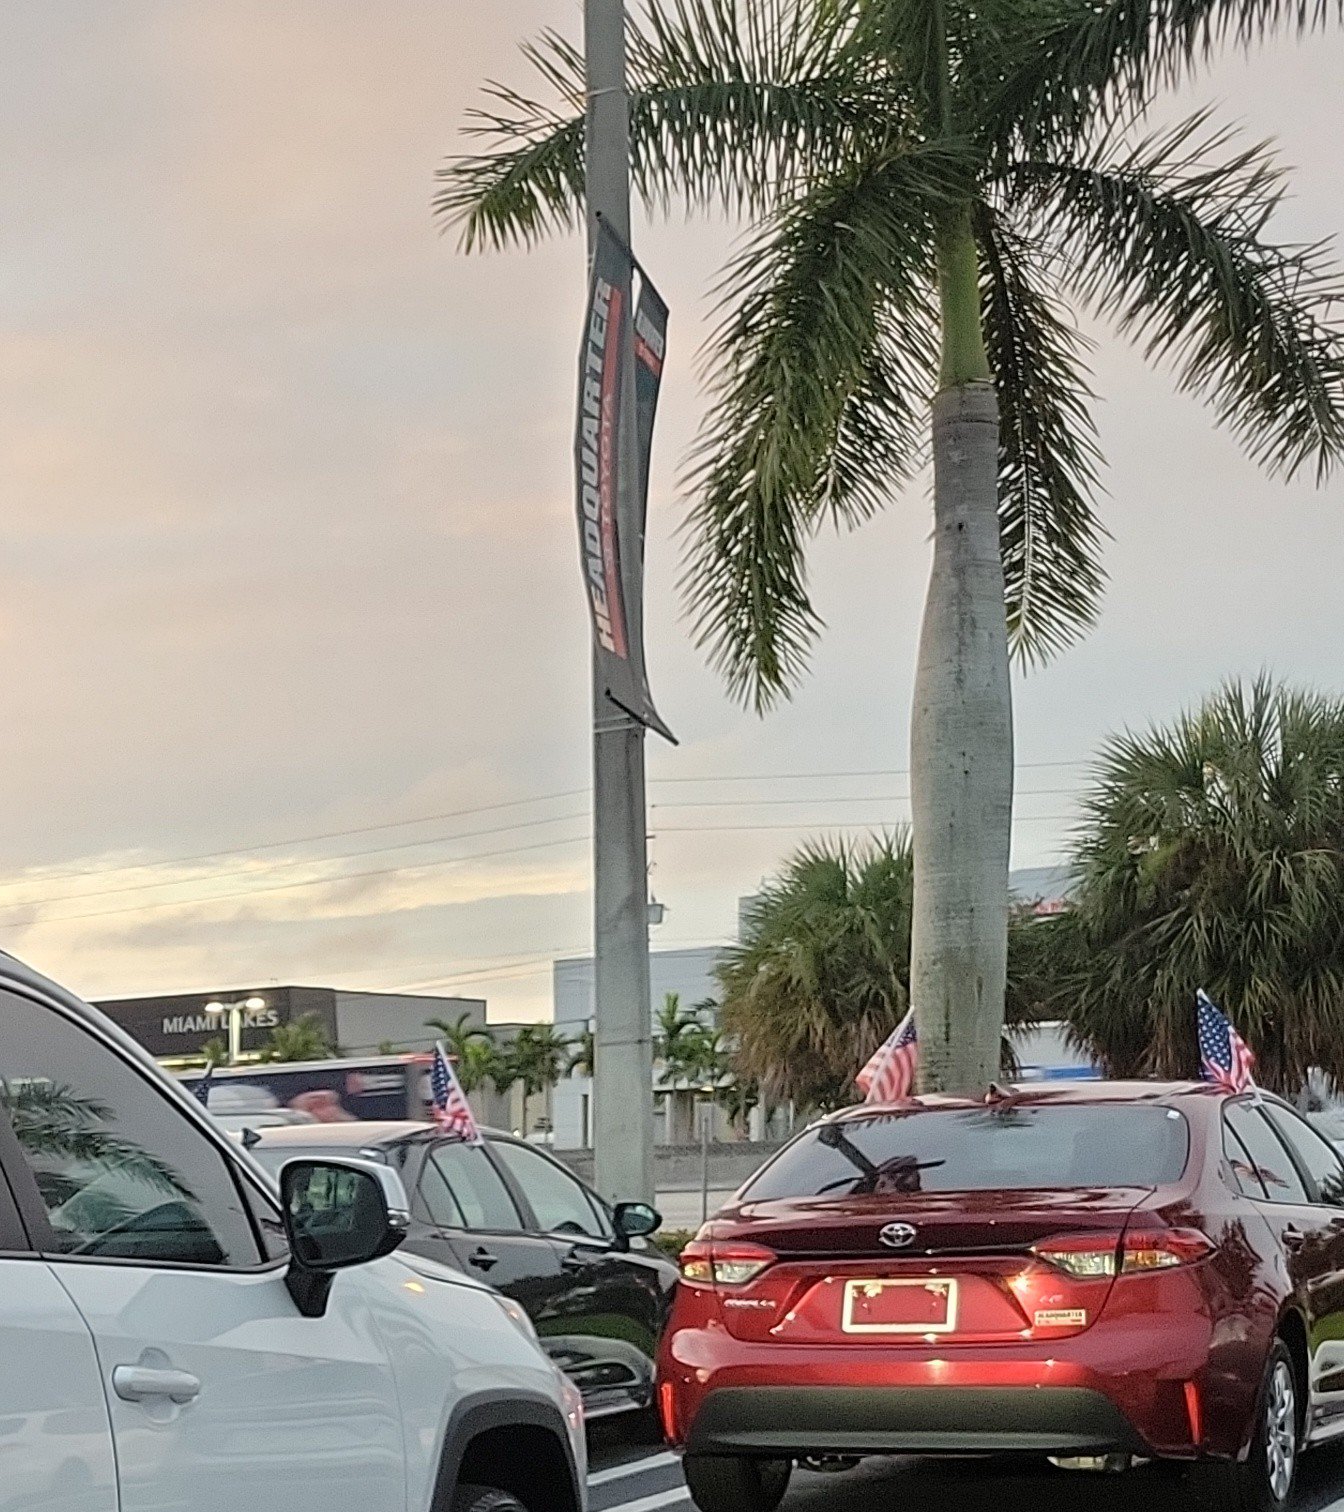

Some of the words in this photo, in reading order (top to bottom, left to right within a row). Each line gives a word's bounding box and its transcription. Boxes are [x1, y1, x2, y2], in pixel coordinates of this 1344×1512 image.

[581, 277, 615, 653] HEADQUARTER
[162, 1015, 217, 1034] MIAMI
[221, 1010, 279, 1030] LKES
